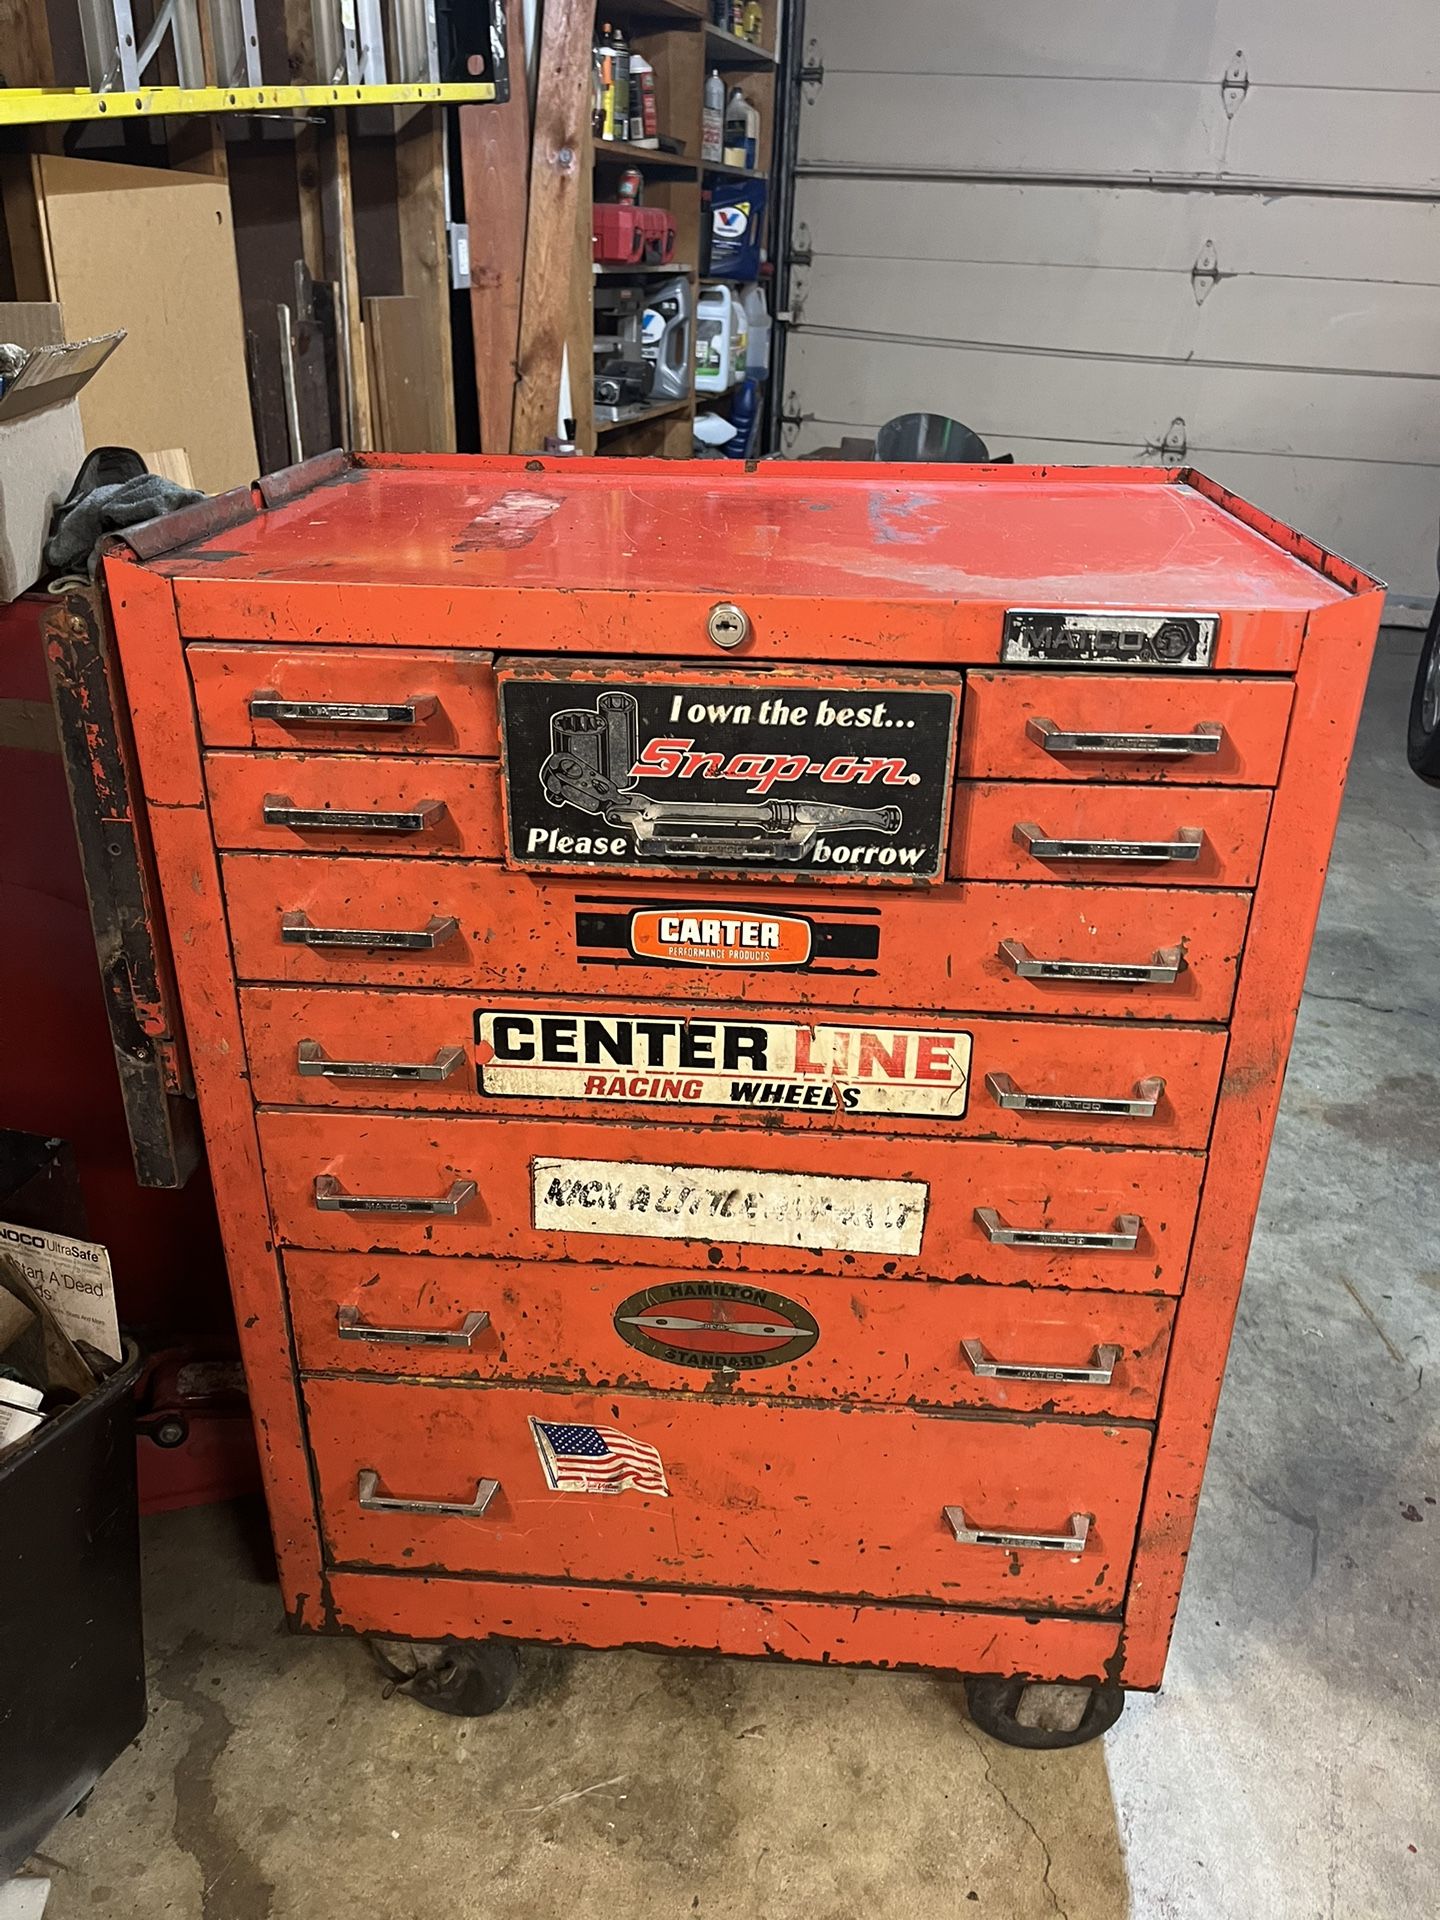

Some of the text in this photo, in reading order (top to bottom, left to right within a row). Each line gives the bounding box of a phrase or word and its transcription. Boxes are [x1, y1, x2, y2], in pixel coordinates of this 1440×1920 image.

[1022, 627, 1143, 651] MATCO
[669, 695, 683, 723] I
[687, 705, 751, 726] own
[759, 697, 809, 726] the
[526, 827, 926, 867] Please borrow
[659, 917, 780, 949] CARTER
[668, 946, 771, 962] PERFORMANCE PRODUCTS
[1070, 966, 1120, 977] MATCO
[493, 1016, 956, 1081] CENTER LINE
[584, 1075, 861, 1108] RACING WHEELS
[1054, 1100, 1101, 1111] MATCO
[365, 1201, 408, 1211] MATCO
[46, 1239, 100, 1263] UltraSafe
[63, 1274, 104, 1298] Dead
[668, 1284, 768, 1305] HAMILTON
[664, 1350, 767, 1368] STANDARD
[1021, 1370, 1064, 1380] MATCO
